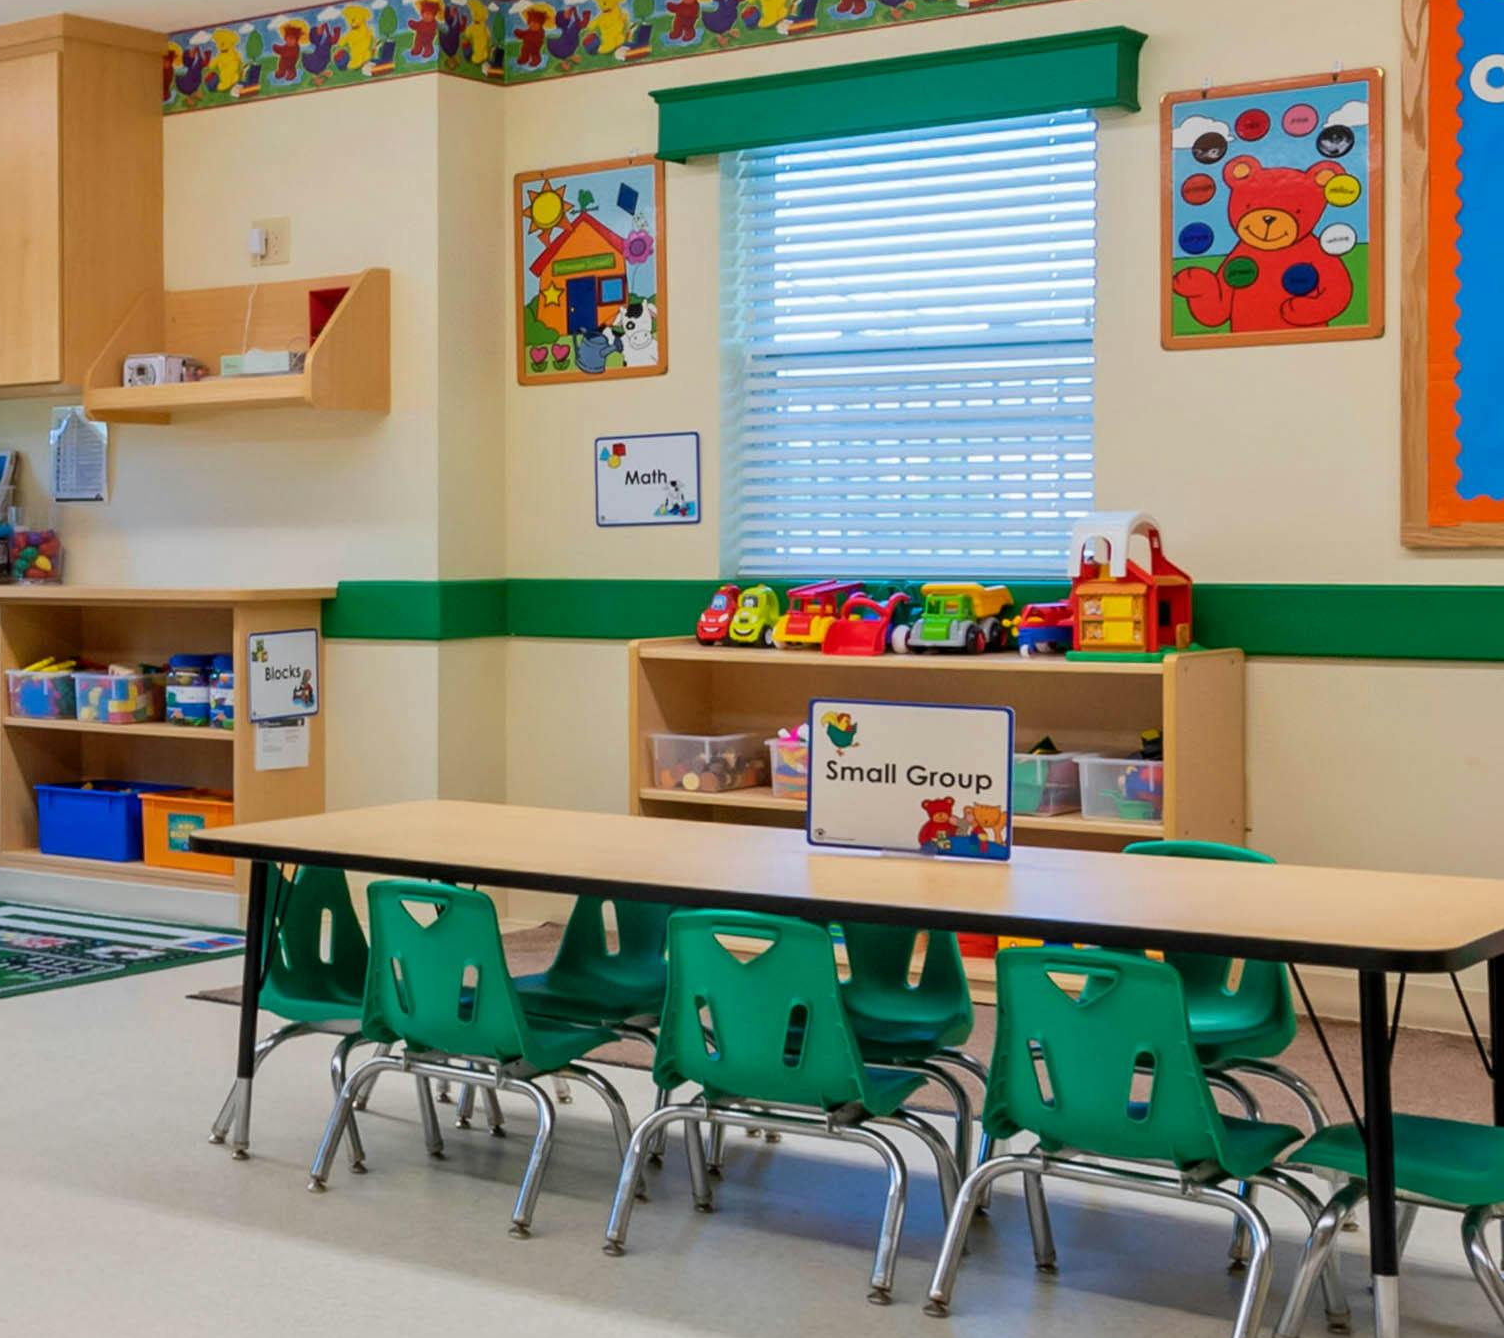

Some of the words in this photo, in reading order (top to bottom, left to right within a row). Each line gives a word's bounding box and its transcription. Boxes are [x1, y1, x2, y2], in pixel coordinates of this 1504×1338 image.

[625, 469, 667, 485] Math
[265, 665, 301, 681] Blocks
[826, 760, 896, 784] Small
[907, 765, 992, 794] Group
